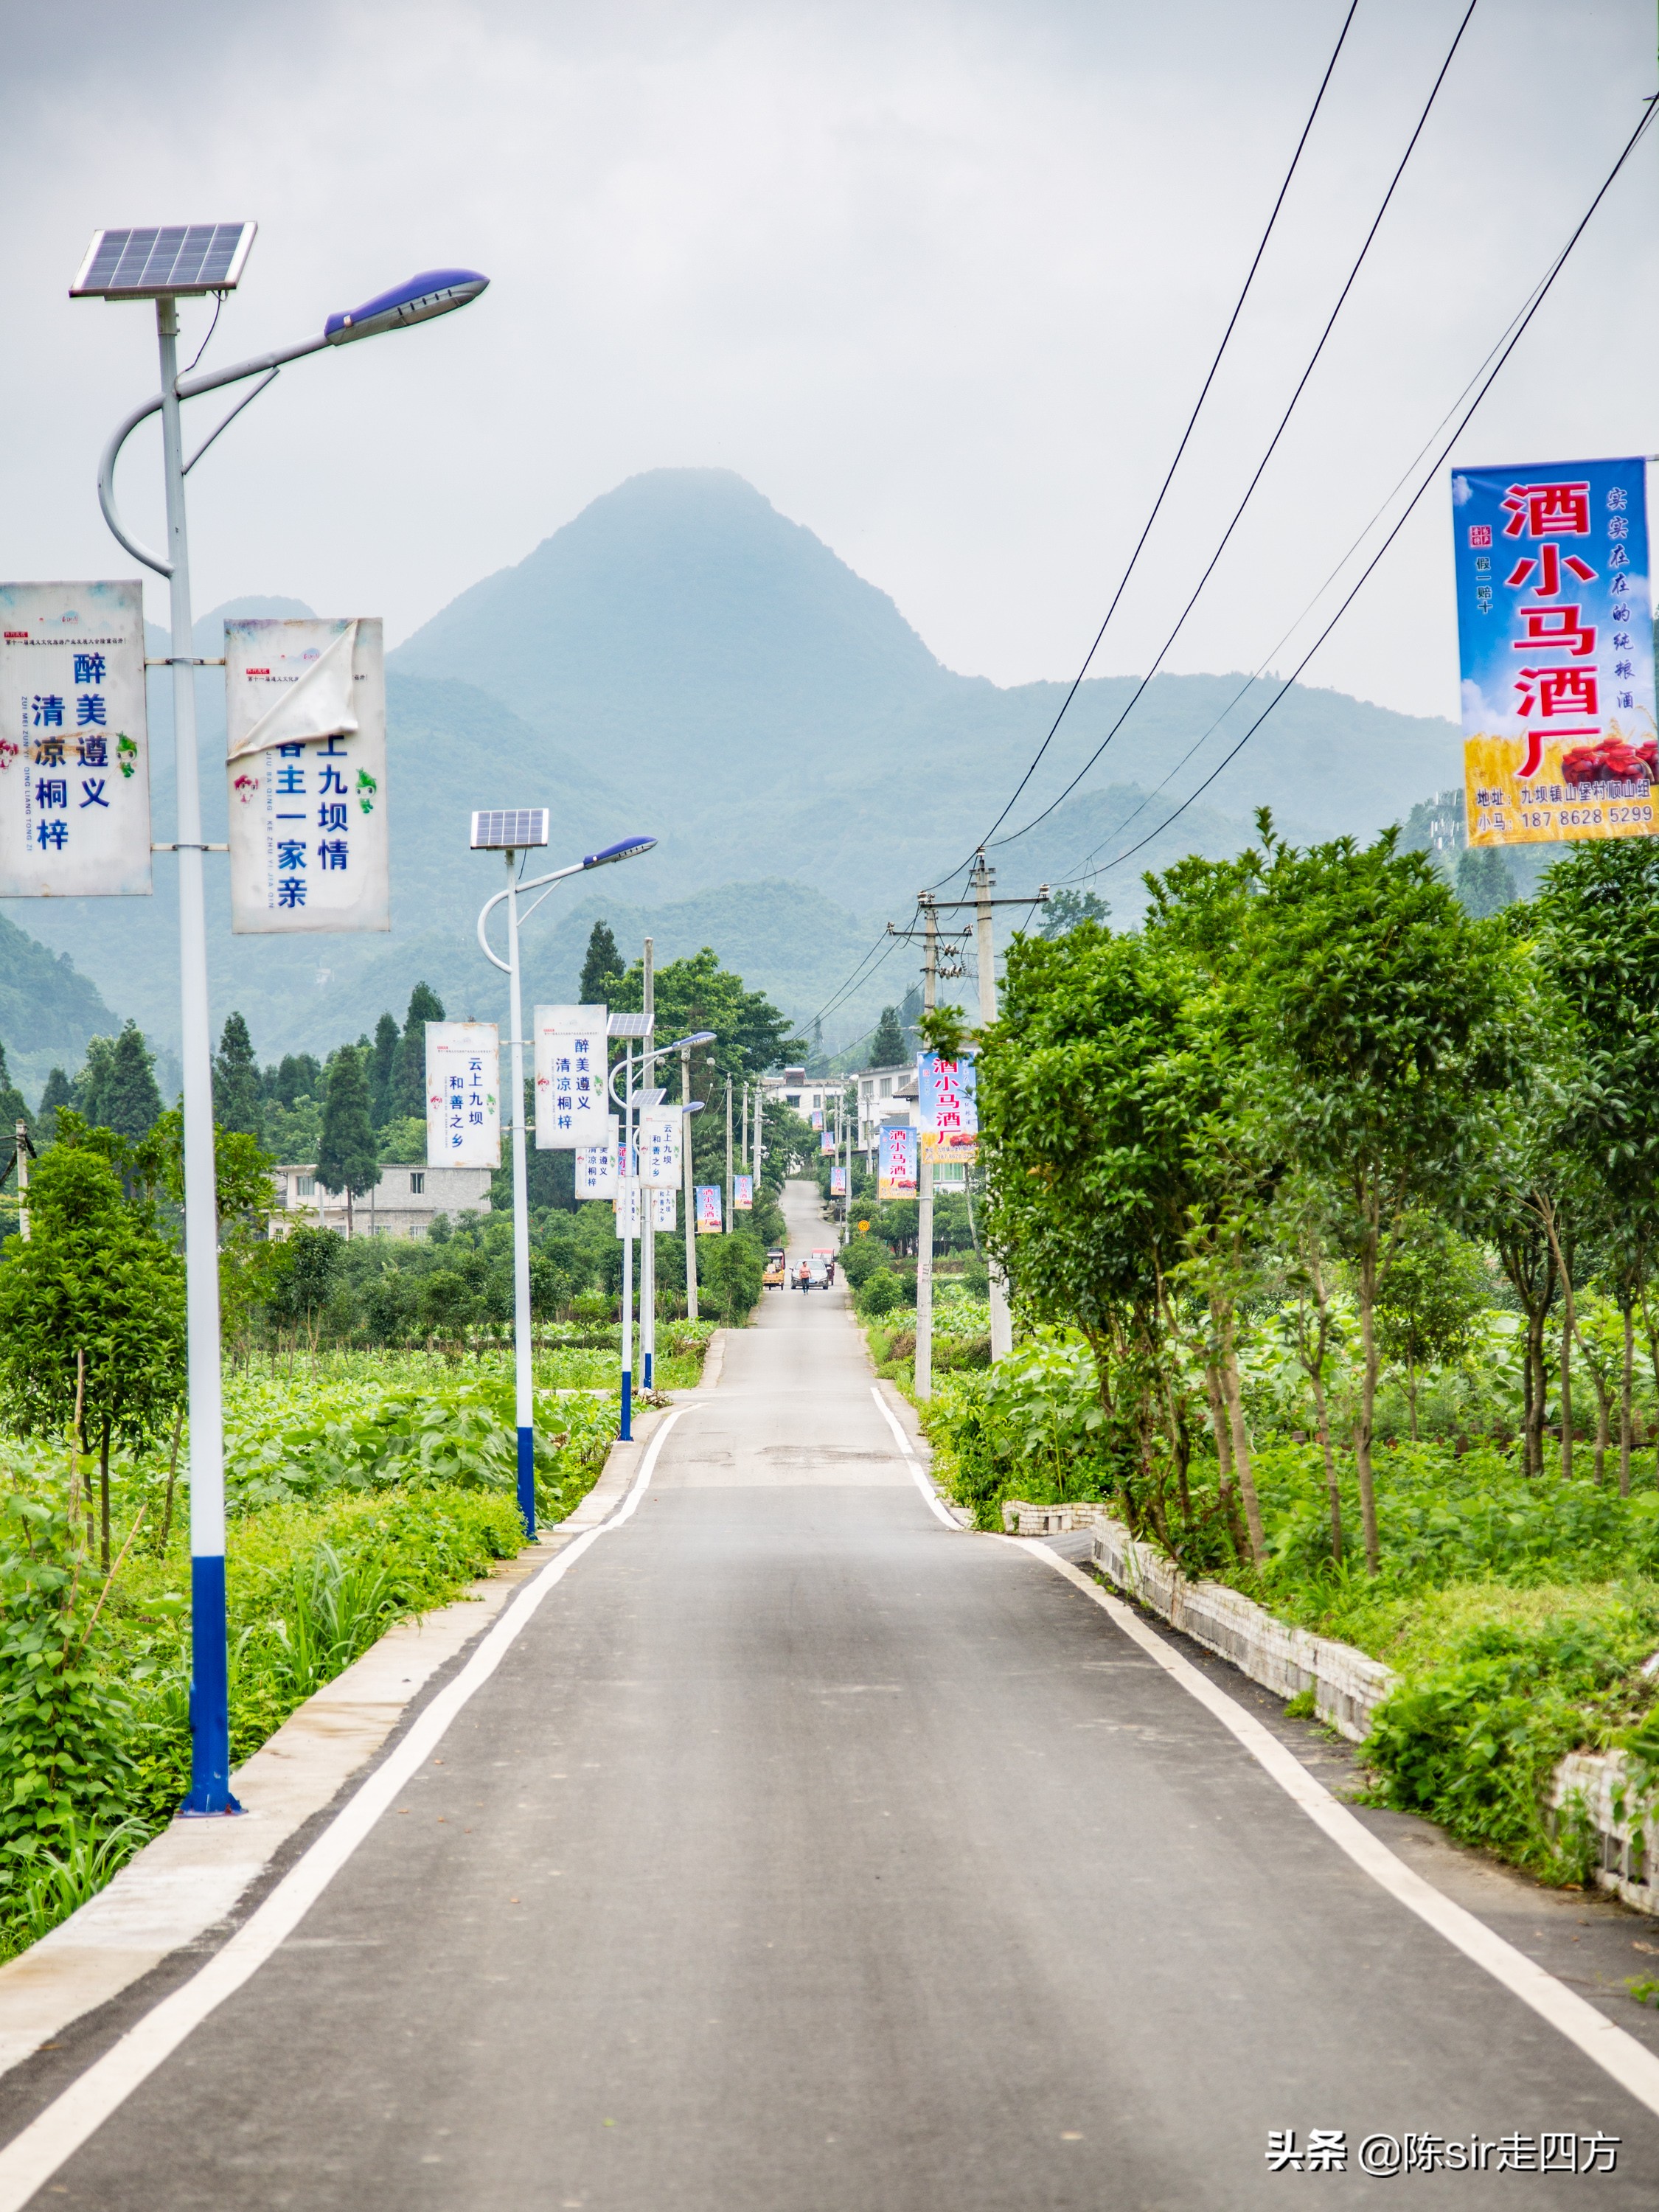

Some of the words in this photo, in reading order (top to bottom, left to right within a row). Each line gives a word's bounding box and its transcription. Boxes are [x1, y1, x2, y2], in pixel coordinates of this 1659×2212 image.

[1476, 557, 1493, 614] 假一赔十
[1607, 486, 1637, 710] 实实在在的纯粮酒
[1500, 481, 1602, 779] 酒小马酒厂
[73, 651, 111, 809] 醉美遵义
[31, 694, 69, 851] 清凉桐梓
[267, 821, 273, 832] KE
[1522, 810, 1552, 828] 187
[1559, 808, 1604, 826] 8628
[1610, 805, 1654, 824] 5299
[468, 1057, 484, 1125] 云上九坝
[556, 1057, 572, 1130] 清凉桐梓
[574, 1038, 591, 1110] 醉美遵义
[933, 1058, 961, 1144] 酒小马酒厂
[449, 1076, 464, 1148] 和善之乡
[663, 1124, 672, 1164] 云上九坝
[652, 1135, 661, 1178] 和善之乡
[889, 1130, 907, 1186] 酒小马酒厂
